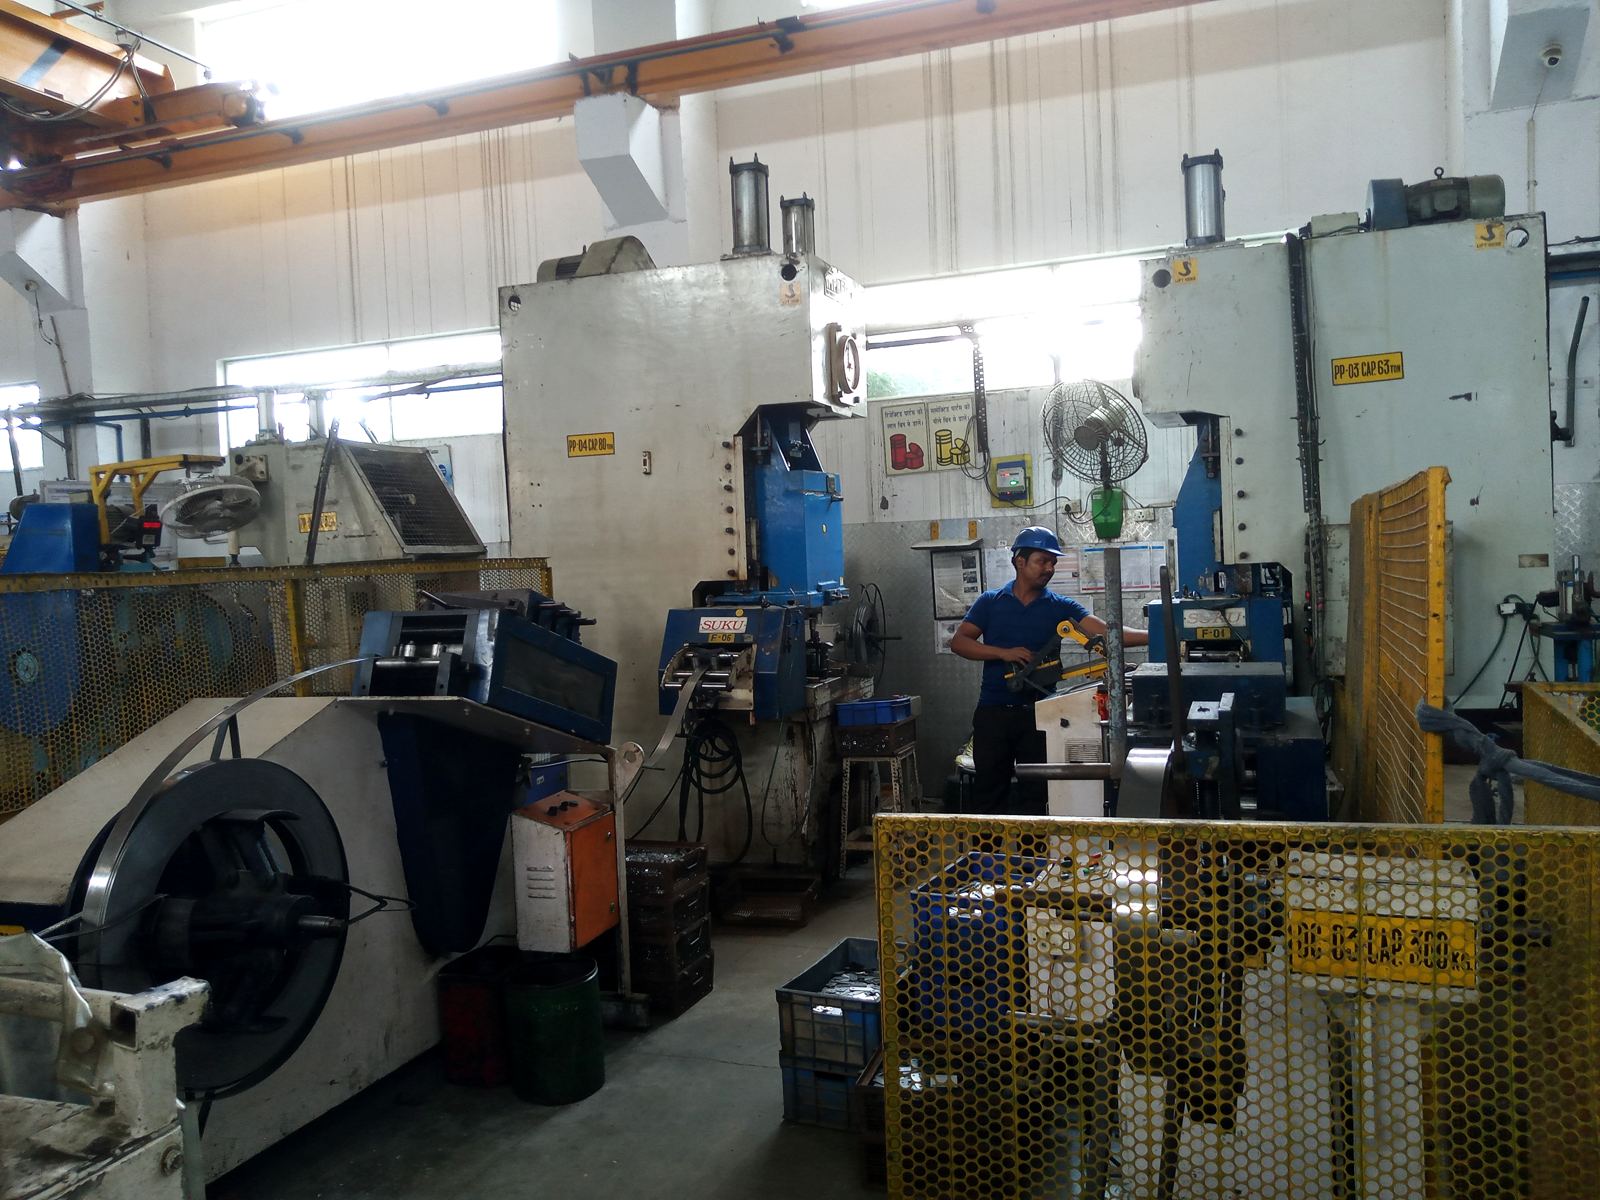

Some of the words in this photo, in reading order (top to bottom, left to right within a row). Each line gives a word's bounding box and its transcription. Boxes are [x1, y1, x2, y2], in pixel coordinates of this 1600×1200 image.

[1334, 362, 1360, 379] PP-03
[1377, 359, 1390, 374] 63
[598, 437, 607, 450] 80
[701, 620, 745, 630] SUKU
